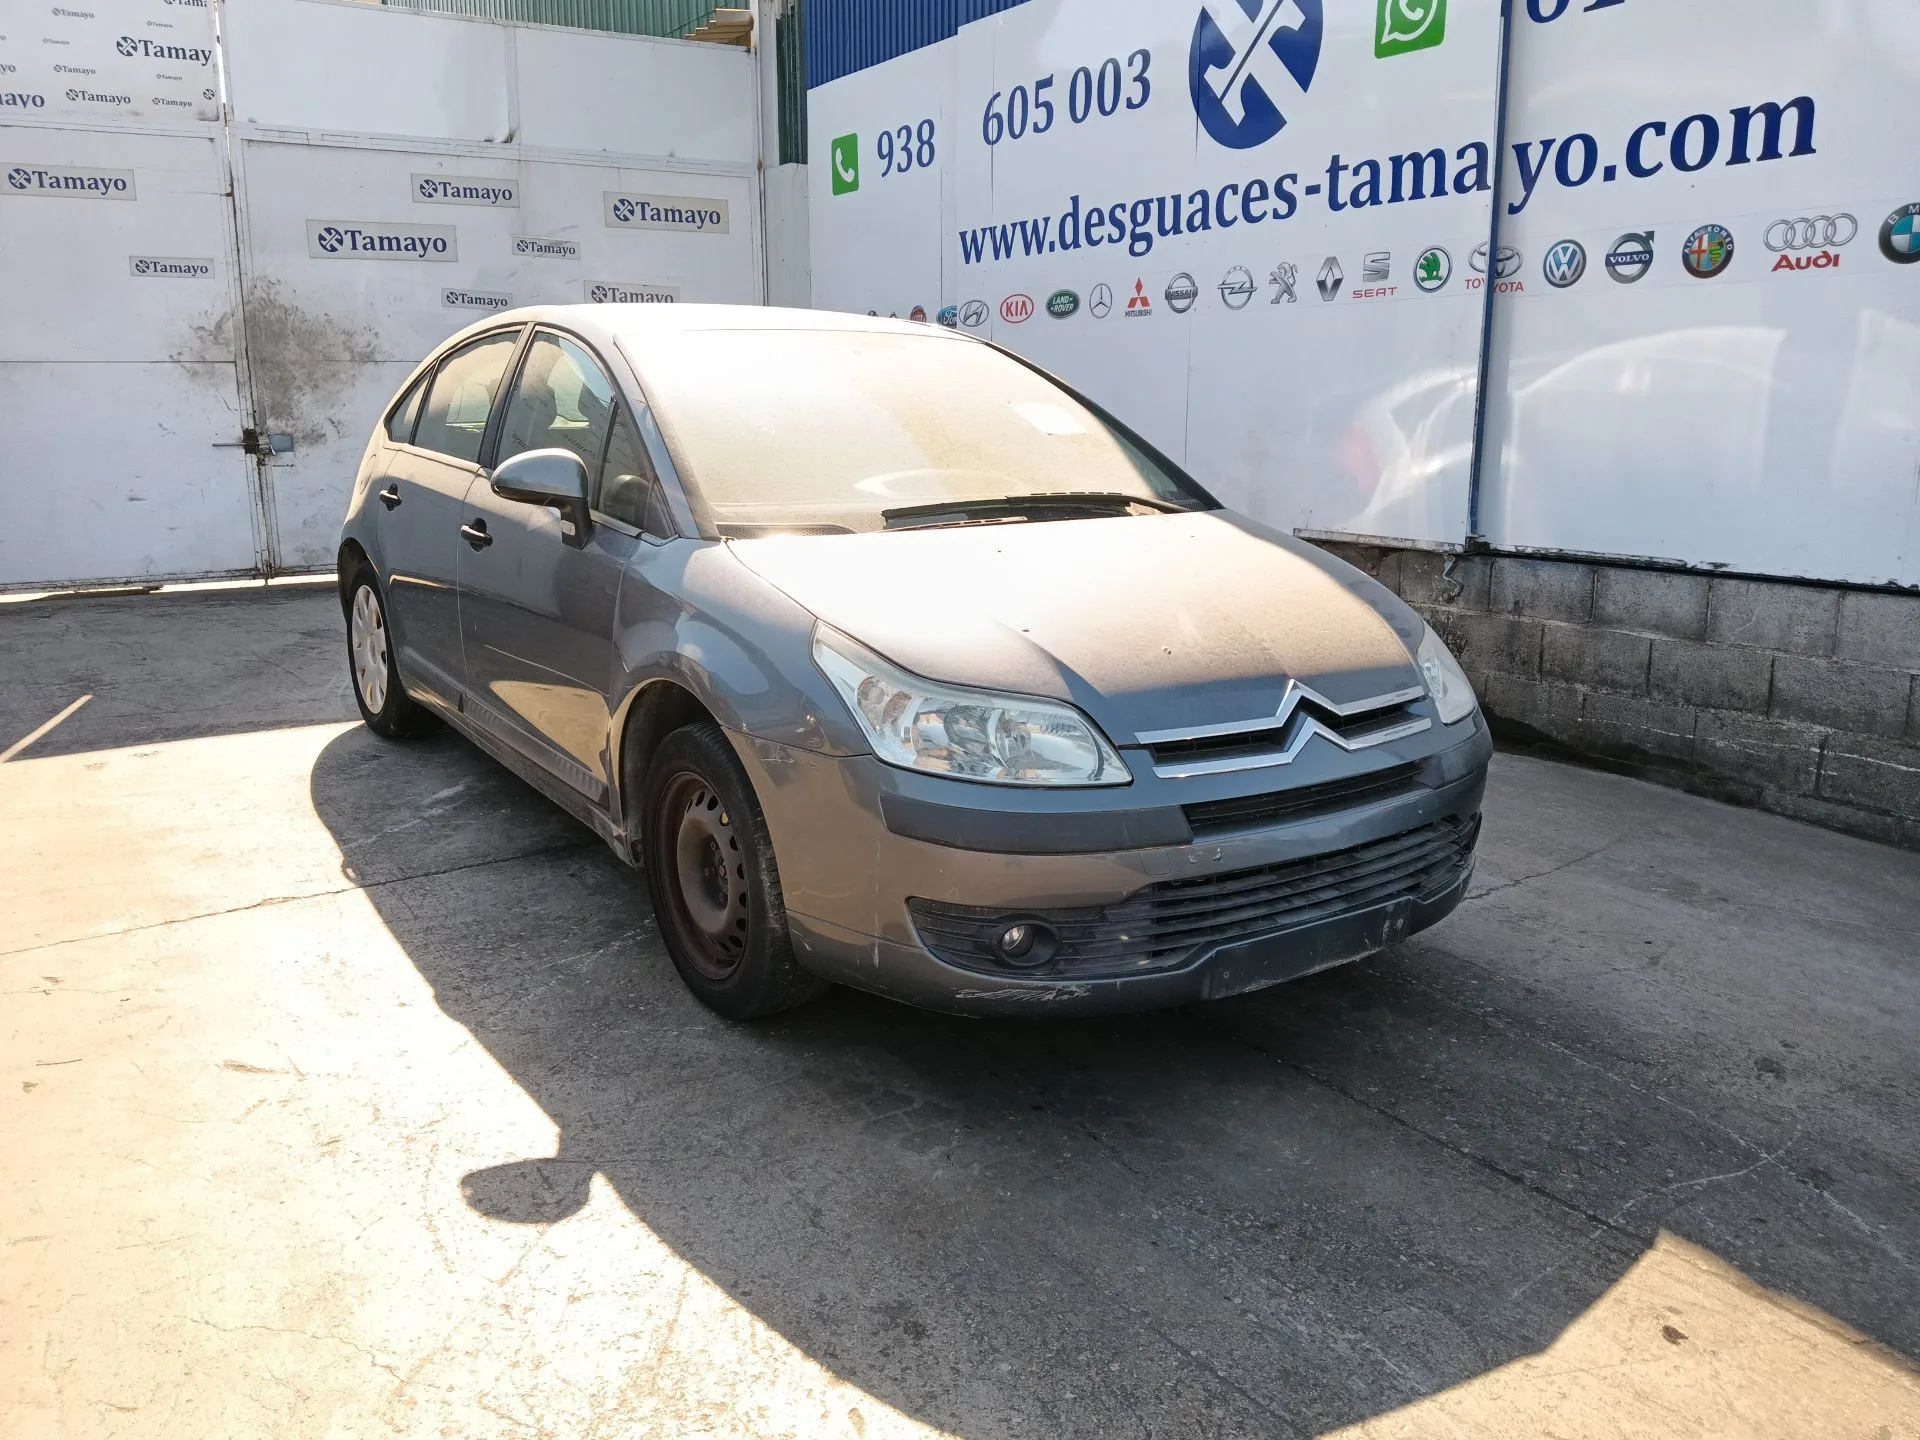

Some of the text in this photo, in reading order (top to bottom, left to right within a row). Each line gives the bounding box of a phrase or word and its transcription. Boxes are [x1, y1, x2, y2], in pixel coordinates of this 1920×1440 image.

[61, 8, 95, 19] Tamayo
[62, 65, 96, 75] Tamayo
[79, 90, 131, 105] Tamayo
[160, 99, 193, 108] Tamayo
[877, 47, 1152, 178] 938 605 003
[32, 170, 127, 196] Tamayo
[958, 93, 1817, 265] www.desguaces-tamayo.com
[438, 181, 513, 205] Tamayo
[635, 201, 721, 229] Tamayo
[345, 229, 448, 258] Tamayo
[529, 241, 576, 257] Tamayo
[1609, 254, 1650, 264] VOLVO
[150, 261, 209, 276] Tamayo
[608, 288, 674, 304] Tamayo
[1053, 296, 1069, 304] LAND
[1352, 287, 1398, 299] SEAT
[458, 293, 508, 309] Tamayo
[1053, 303, 1074, 312] ROVER
[1005, 301, 1028, 318] KIA
[1124, 308, 1152, 318] MITSUBISHI
